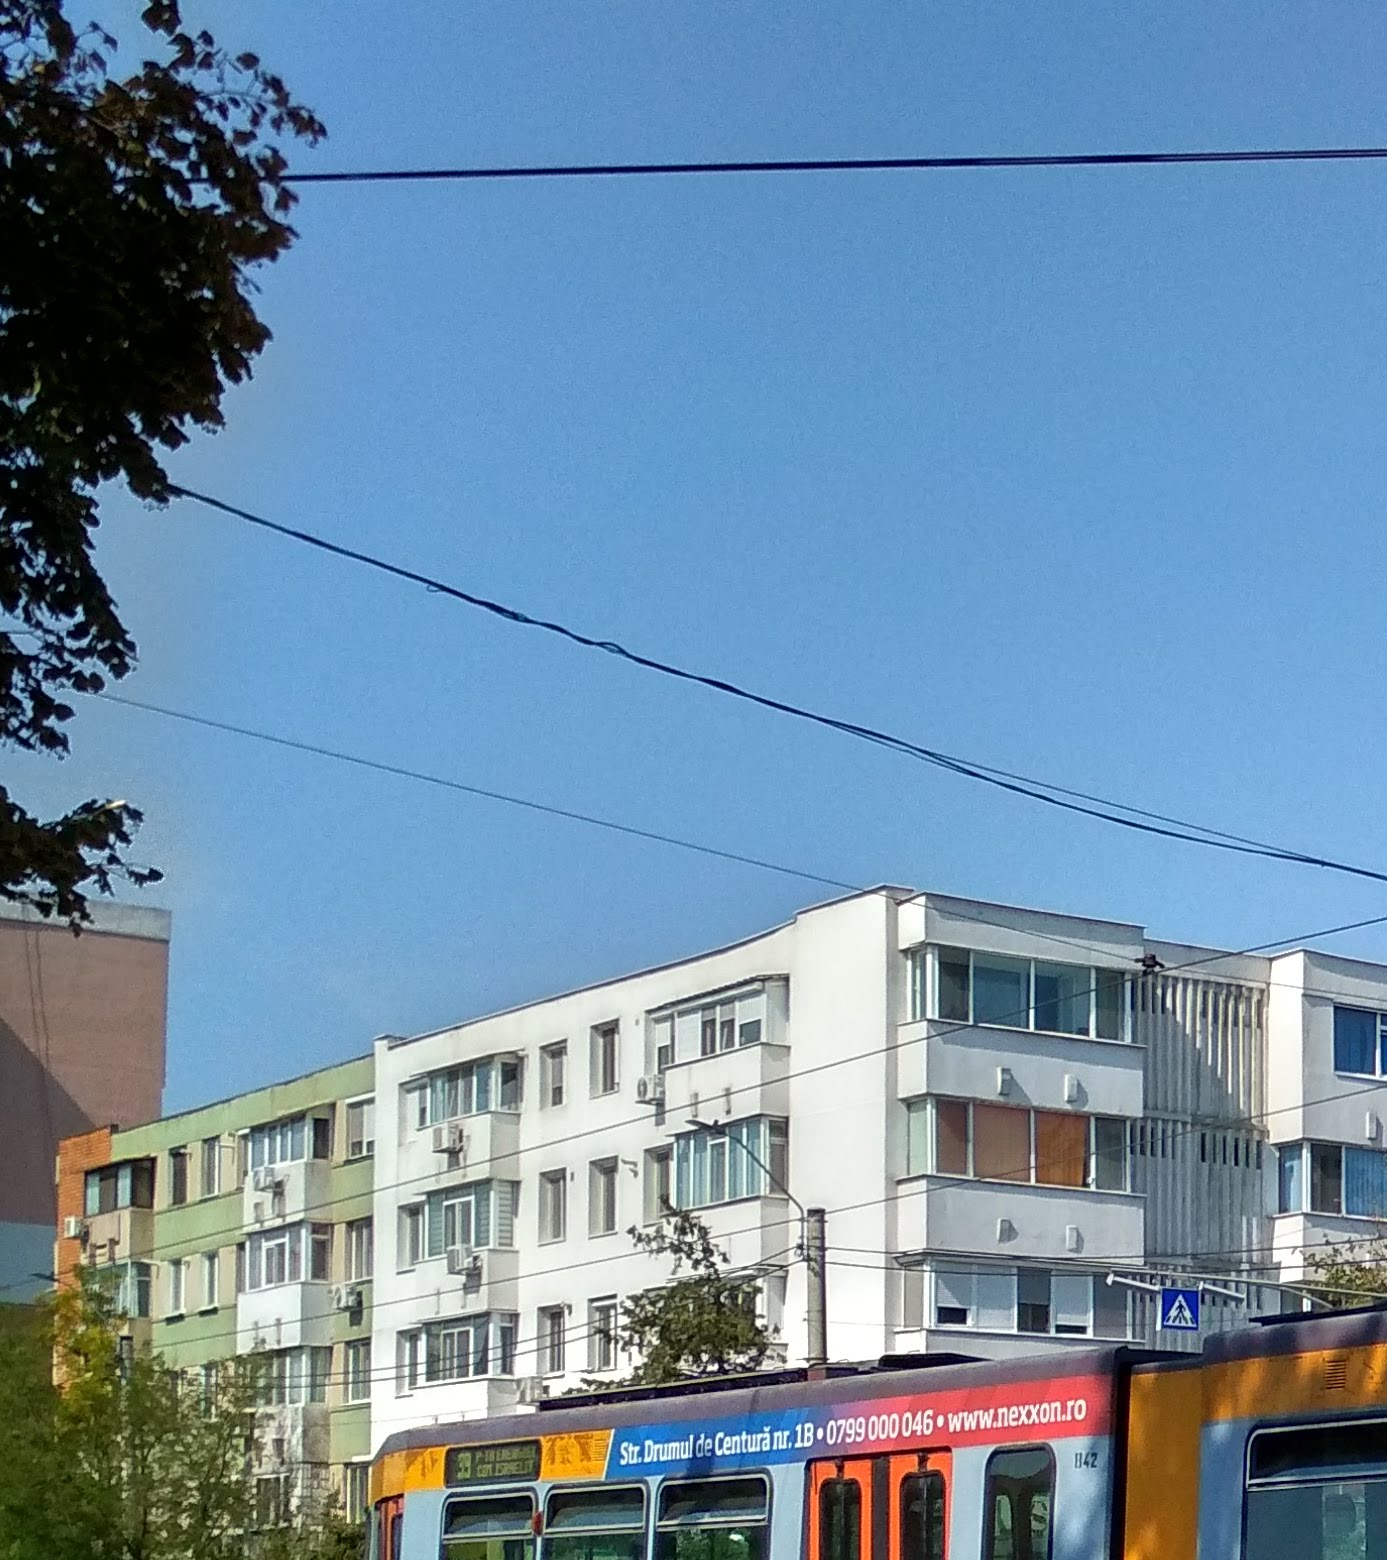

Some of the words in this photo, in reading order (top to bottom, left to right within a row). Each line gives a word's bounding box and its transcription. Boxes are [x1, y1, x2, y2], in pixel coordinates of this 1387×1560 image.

[619, 1441, 641, 1465] Str.
[644, 1434, 694, 1463] Drumul
[695, 1433, 713, 1458] de
[715, 1426, 770, 1457] Centură
[772, 1430, 793, 1451] nr.
[794, 1422, 814, 1448] 1B
[826, 1417, 865, 1446] 0799
[868, 1413, 899, 1441] 000
[901, 1409, 934, 1438] 046
[947, 1398, 1087, 1434] www.nexxon.ro
